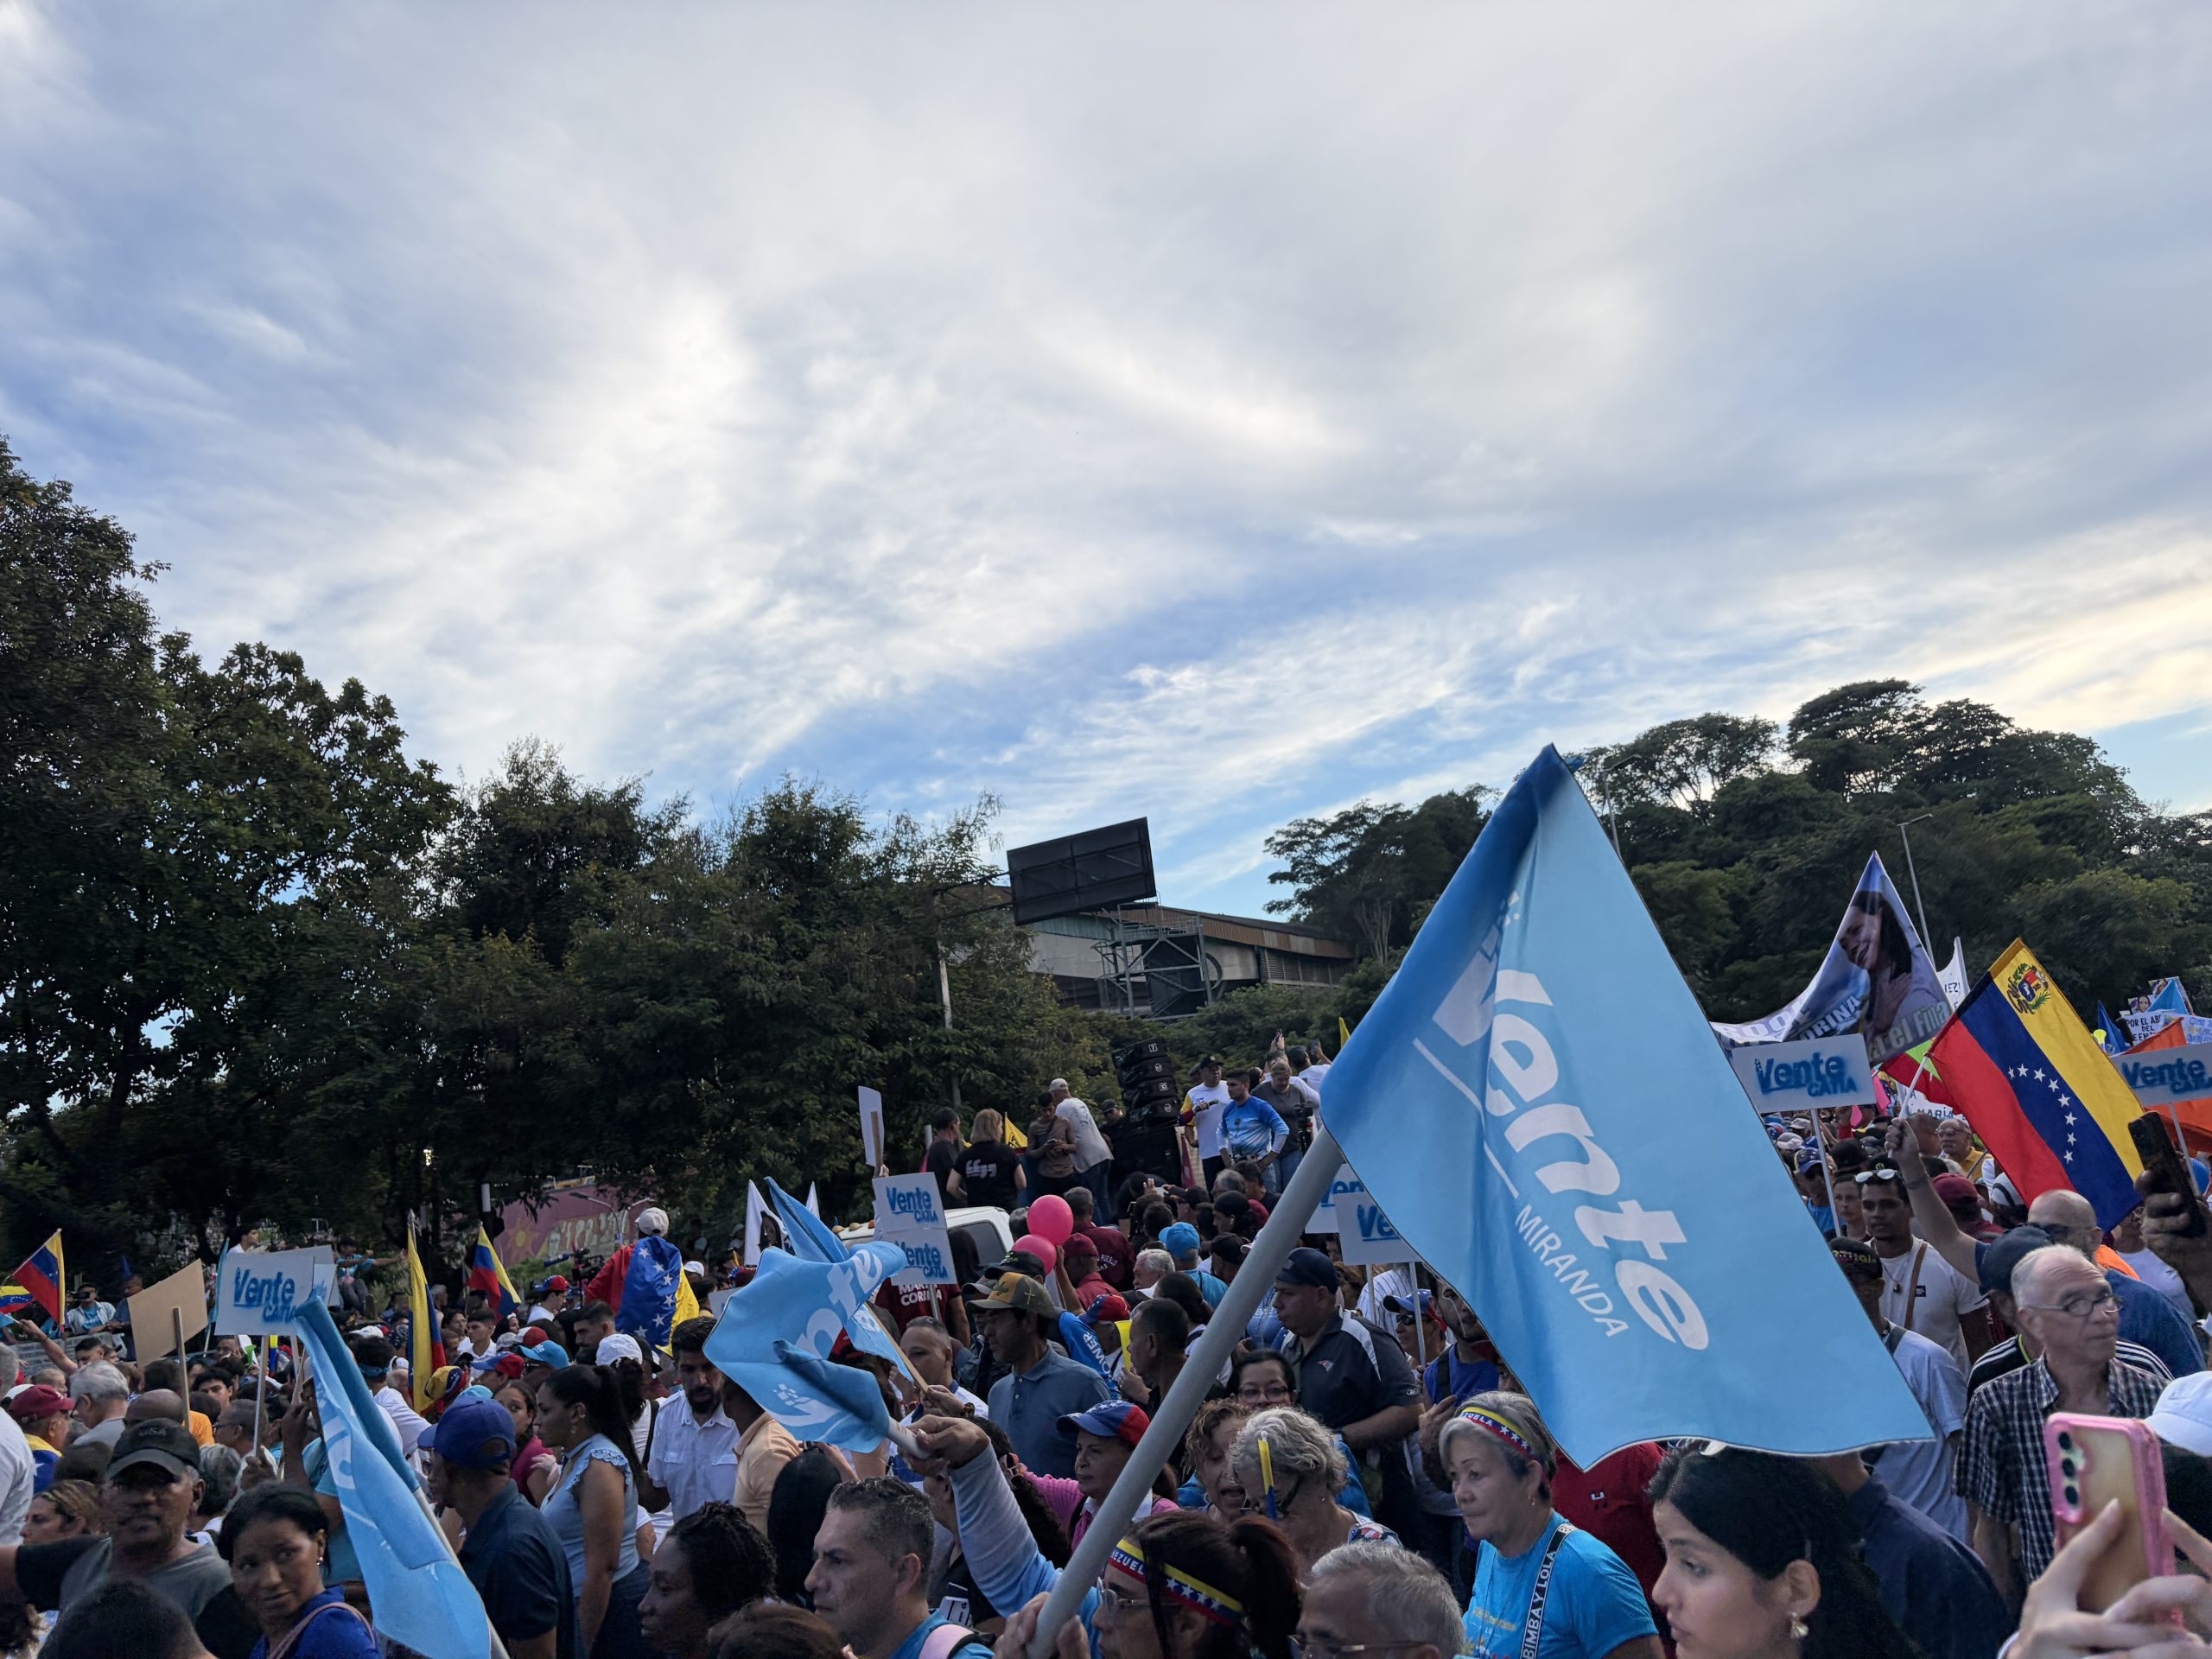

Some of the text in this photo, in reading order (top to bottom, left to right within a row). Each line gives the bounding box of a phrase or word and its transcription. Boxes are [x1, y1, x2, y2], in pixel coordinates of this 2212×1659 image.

[1798, 995, 1860, 1040] ORINA
[1755, 1052, 1846, 1095] Vente
[1807, 1077, 1858, 1097] CATIA
[2121, 1058, 2206, 1089] Vente
[1432, 916, 1709, 1350] Vente
[886, 1186, 932, 1211] Vente
[914, 1211, 938, 1223] CATIA
[233, 1267, 296, 1307] Vente
[923, 1266, 949, 1279] CATIA
[1515, 1205, 1630, 1338] MIRANDA
[900, 1288, 943, 1306] CORIA
[1083, 1332, 1112, 1375] OWER
[1536, 1550, 1558, 1588] LOLA
